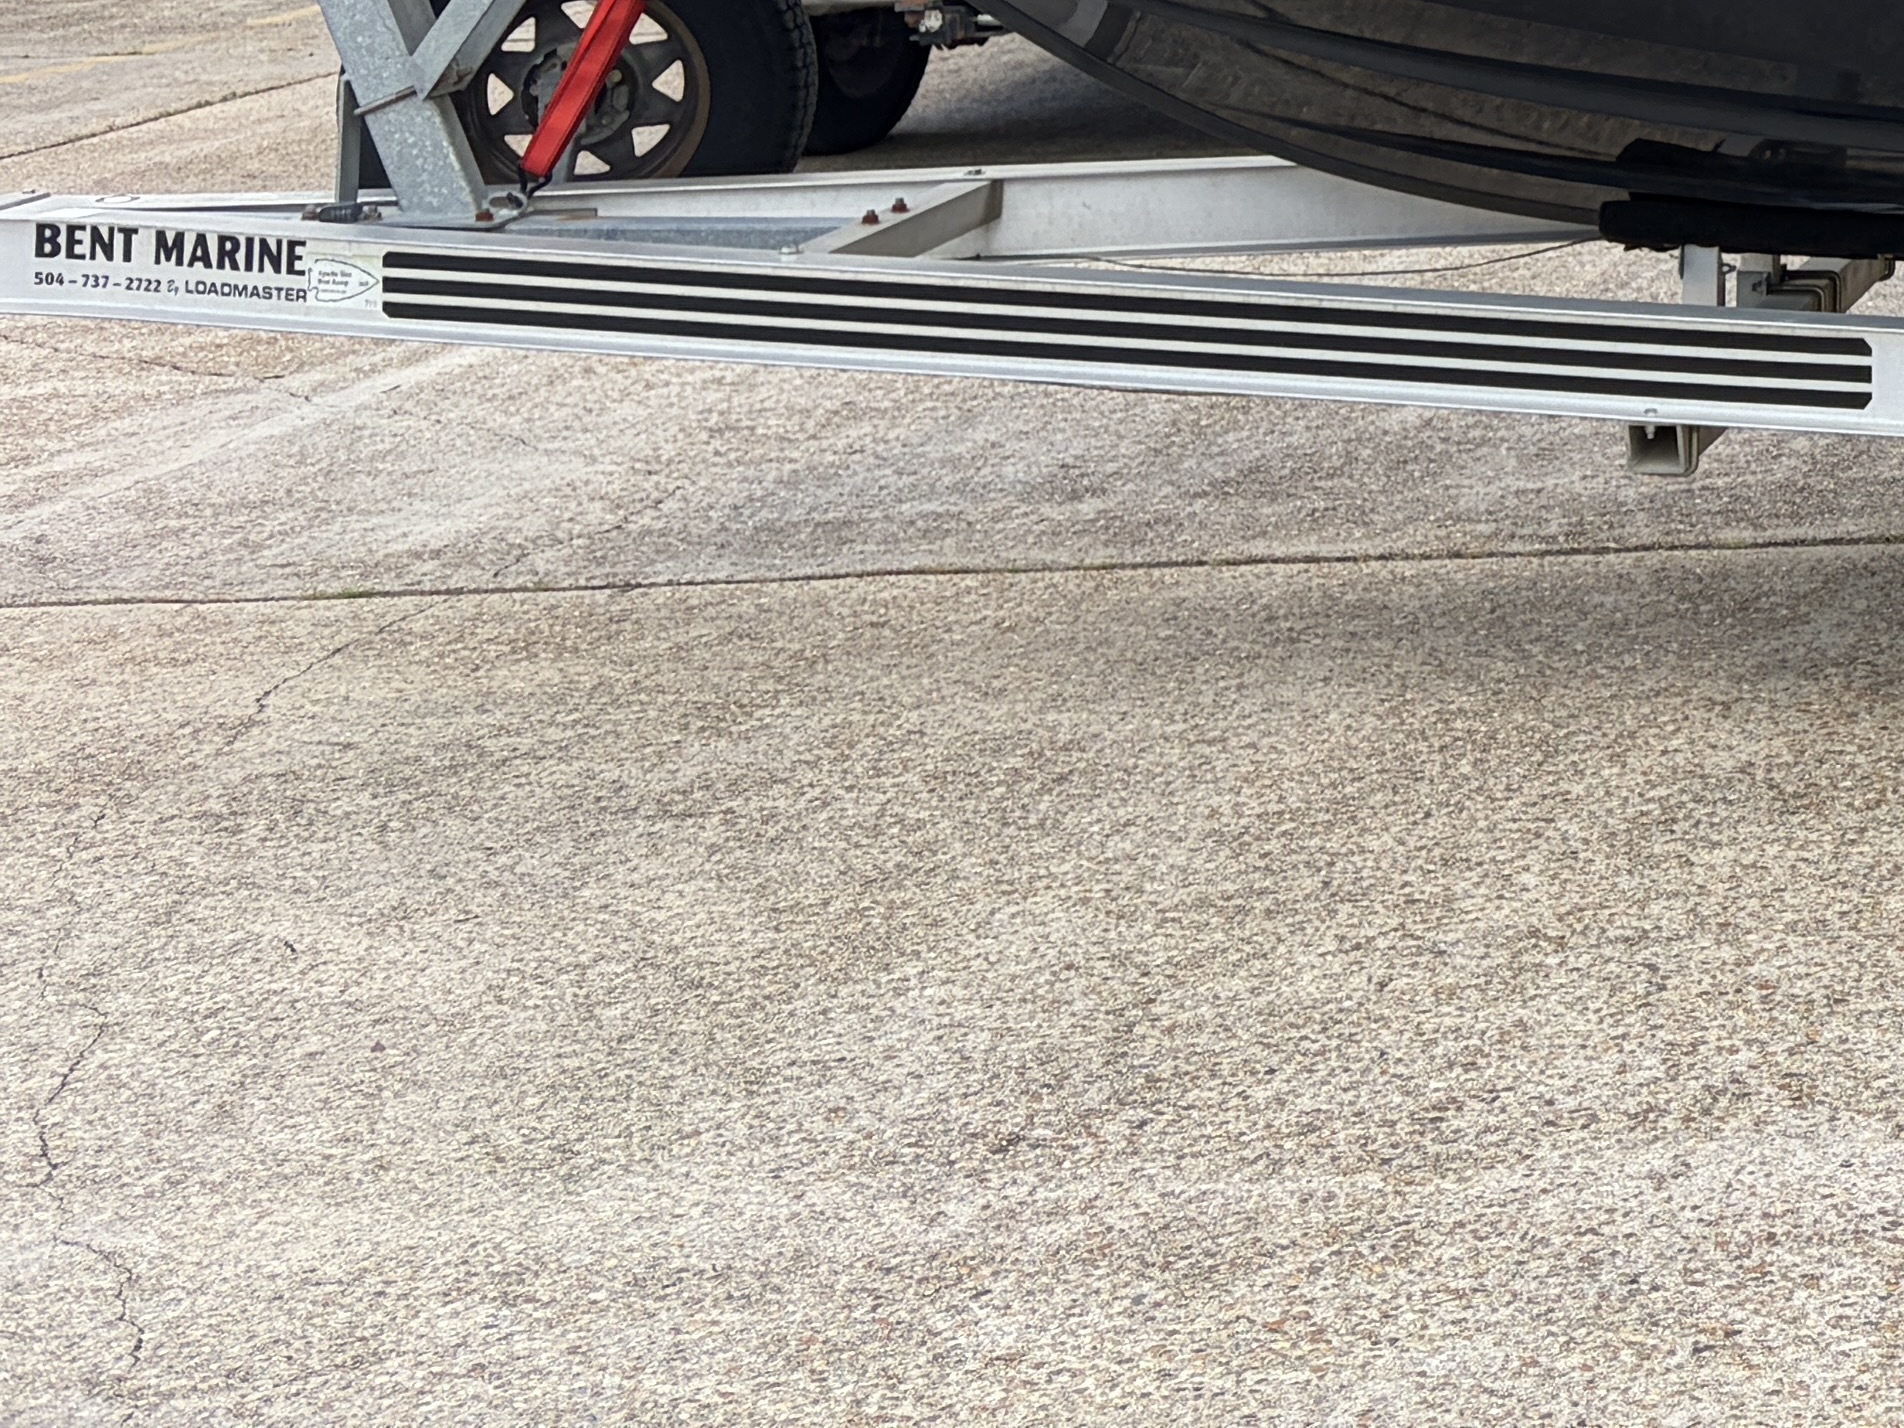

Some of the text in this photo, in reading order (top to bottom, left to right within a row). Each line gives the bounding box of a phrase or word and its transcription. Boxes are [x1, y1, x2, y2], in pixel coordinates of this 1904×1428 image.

[34, 223, 308, 276] BENT MARINE
[185, 279, 307, 302] LOADMASTER
